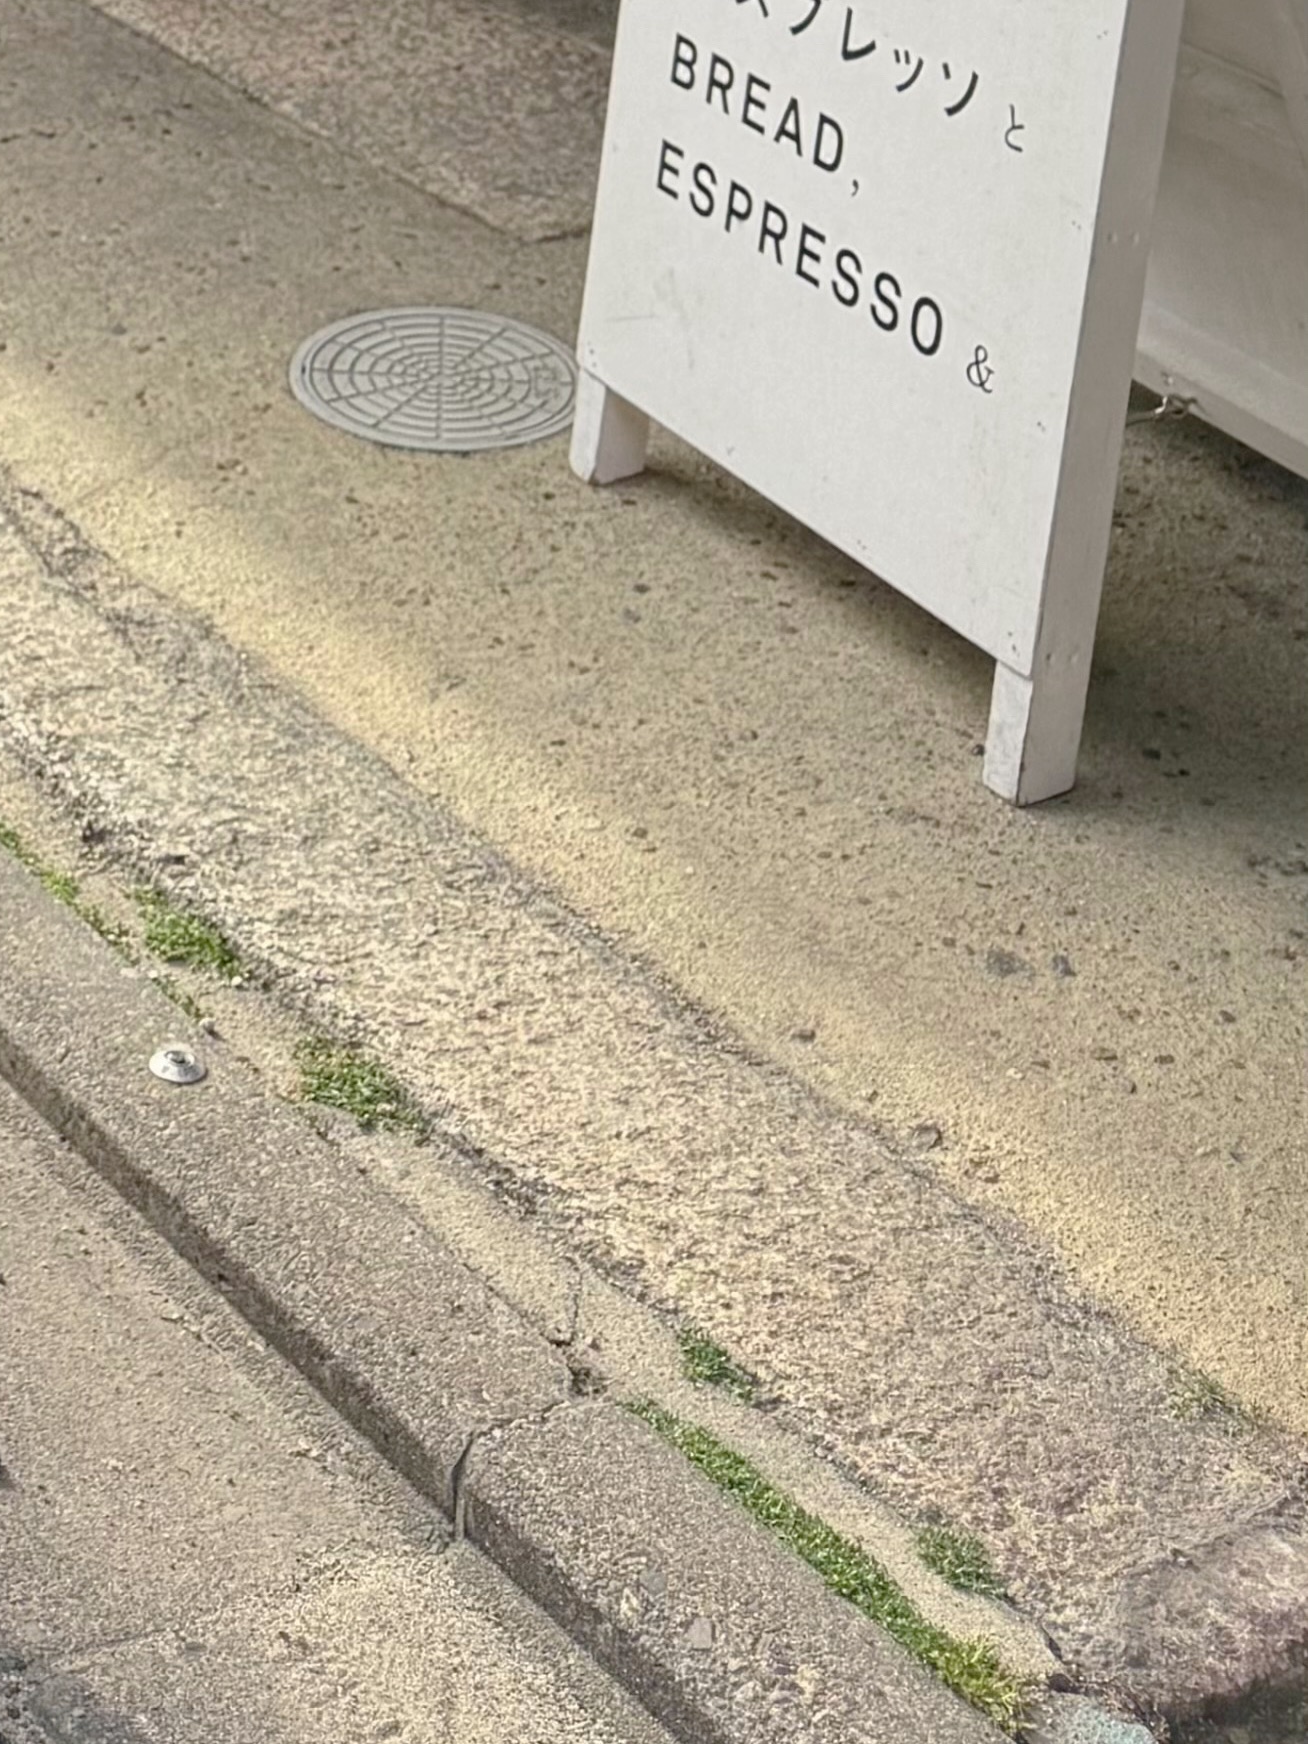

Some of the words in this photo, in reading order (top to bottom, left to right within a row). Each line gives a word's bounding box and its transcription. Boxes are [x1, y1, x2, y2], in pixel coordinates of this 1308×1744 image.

[670, 33, 861, 197] BREAD,
[656, 139, 945, 357] ESPRESSO
[965, 345, 996, 394] &
